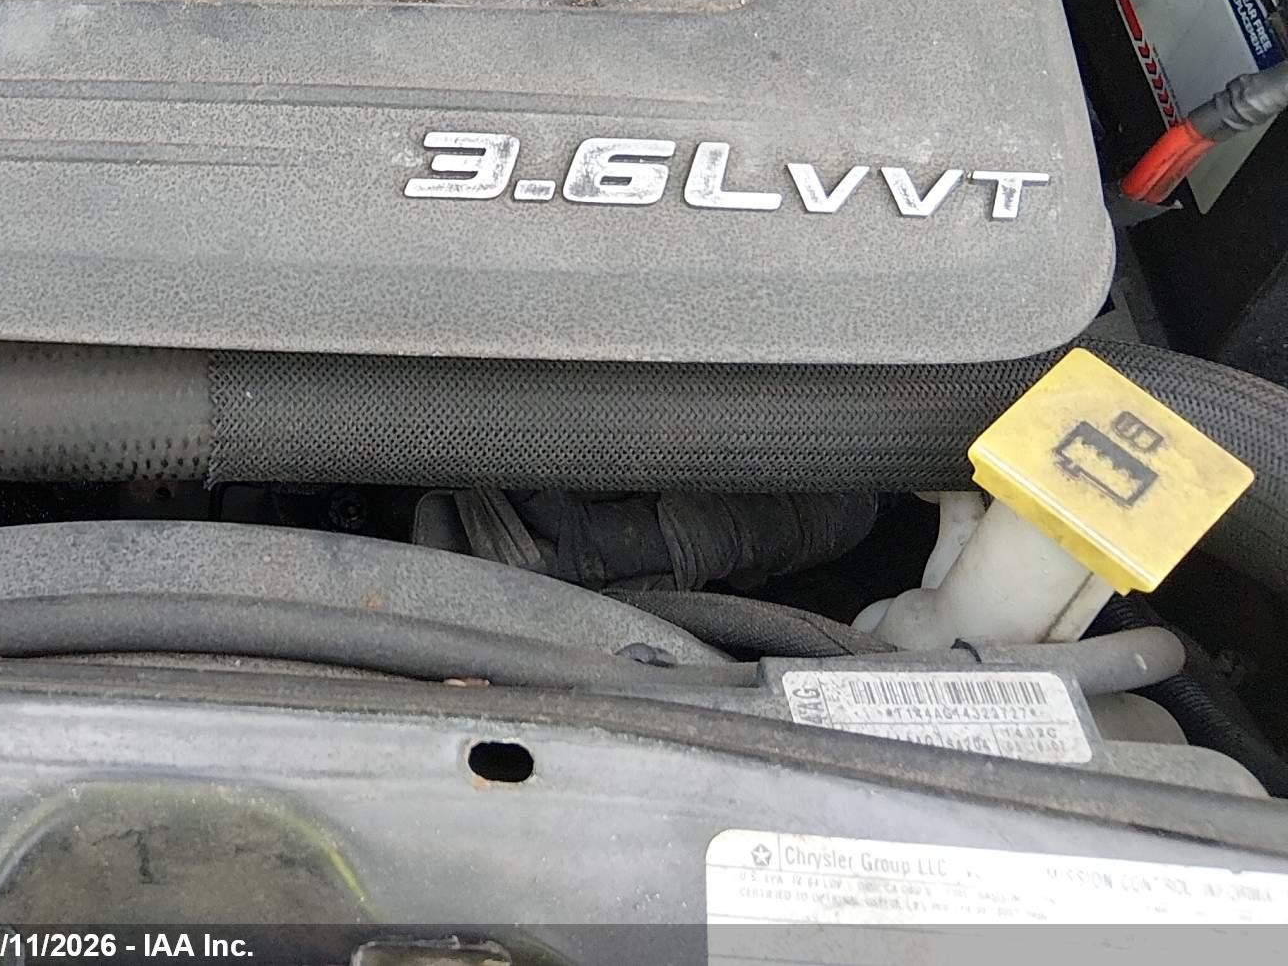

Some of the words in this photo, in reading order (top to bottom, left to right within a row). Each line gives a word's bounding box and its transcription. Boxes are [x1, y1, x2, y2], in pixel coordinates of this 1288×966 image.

[1253, 19, 1272, 52] FREE
[403, 131, 782, 210] 3.6L
[787, 163, 1050, 219] VVT
[785, 845, 853, 871] Chrysler
[861, 853, 911, 877] Group
[918, 858, 948, 877] LLC
